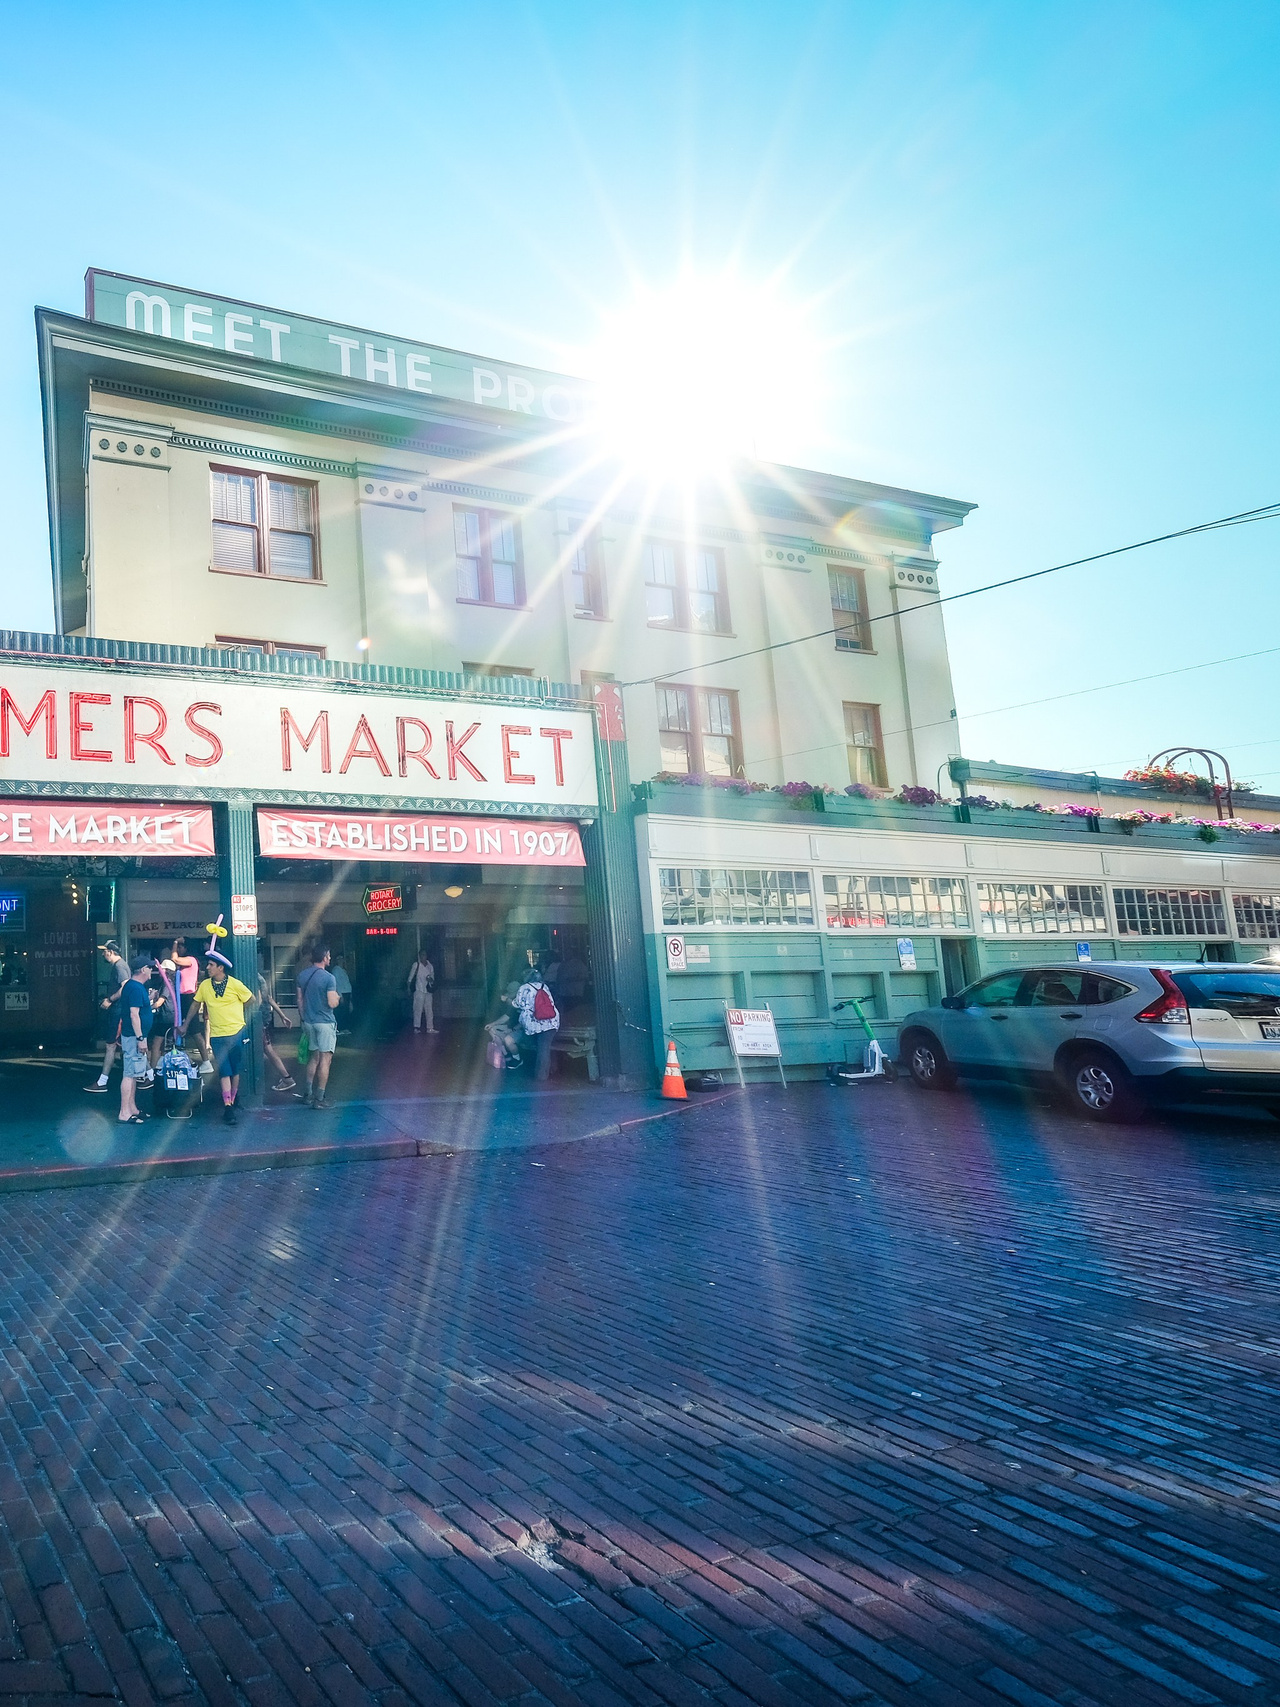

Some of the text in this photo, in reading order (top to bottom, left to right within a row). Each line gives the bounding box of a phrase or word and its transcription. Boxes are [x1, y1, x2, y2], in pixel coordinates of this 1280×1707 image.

[125, 290, 600, 425] MEET THE PRO
[279, 706, 574, 787] MARKET
[48, 814, 196, 845] MARKET
[272, 819, 570, 856] ESTABLISHED IN 1907
[370, 889, 395, 900] ROTARY
[235, 904, 254, 912] STOPS
[366, 897, 401, 912] GROCERY
[129, 921, 204, 933] PIKE PLACE
[43, 931, 78, 945] LOWER
[34, 950, 87, 959] MARKET
[42, 964, 81, 978] LEVELS
[730, 1010, 770, 1023] NO PARKING
